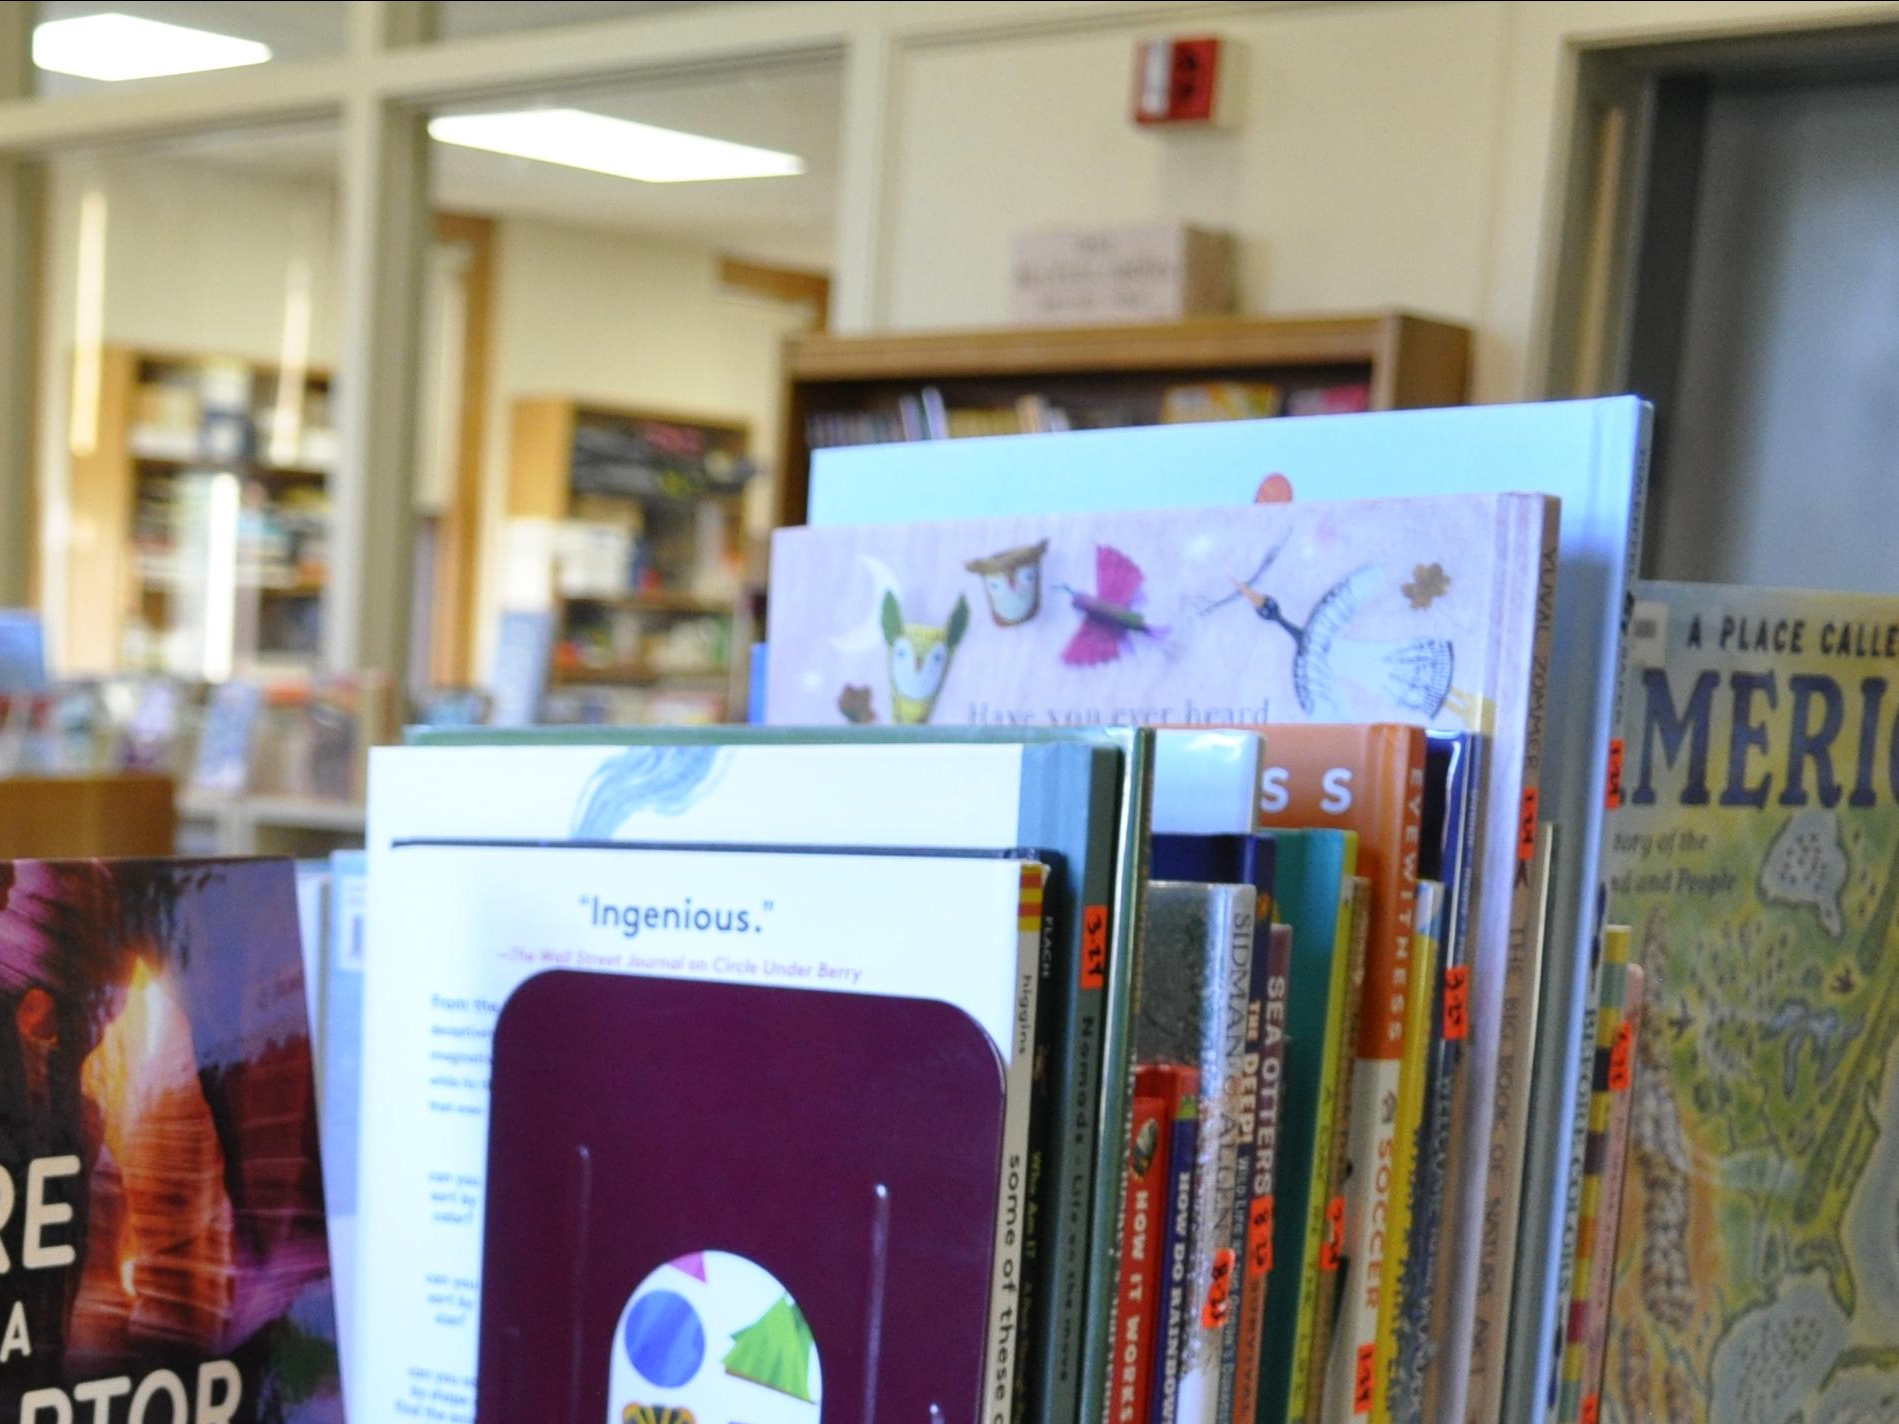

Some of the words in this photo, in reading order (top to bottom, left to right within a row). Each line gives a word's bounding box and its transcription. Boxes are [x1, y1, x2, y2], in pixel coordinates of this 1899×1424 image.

[1719, 615, 1806, 654] PLACE
[970, 702, 1035, 727] Have
[1183, 699, 1269, 727] heard
[1612, 667, 1899, 809] MERI
[1389, 768, 1424, 1042] EYEWITNESS
[576, 949, 621, 969] Street
[627, 953, 684, 972] Journal
[714, 957, 757, 977] Circle
[764, 960, 813, 981] Under
[819, 963, 863, 987] Berry
[1040, 916, 1053, 977] FLACH
[1017, 975, 1033, 1054] higgins
[1224, 912, 1251, 1060] SIDMAN
[1246, 1000, 1261, 1041] THE
[1263, 976, 1287, 1046] SEA
[1075, 1016, 1095, 1144] Nomads
[1236, 1052, 1260, 1146] DEEP!
[1253, 1057, 1282, 1195] OTTERS
[1005, 1154, 1020, 1246] some
[1069, 1174, 1083, 1224] Life
[1133, 1190, 1149, 1261] HOW
[1175, 1171, 1190, 1237] HOW
[1365, 1137, 1394, 1309] SOCCER
[1001, 1258, 1017, 1292] of
[1129, 1273, 1144, 1302] IT
[1171, 1242, 1185, 1279] DO
[994, 1306, 1013, 1401] these
[1120, 1314, 1141, 1422] WORKS
